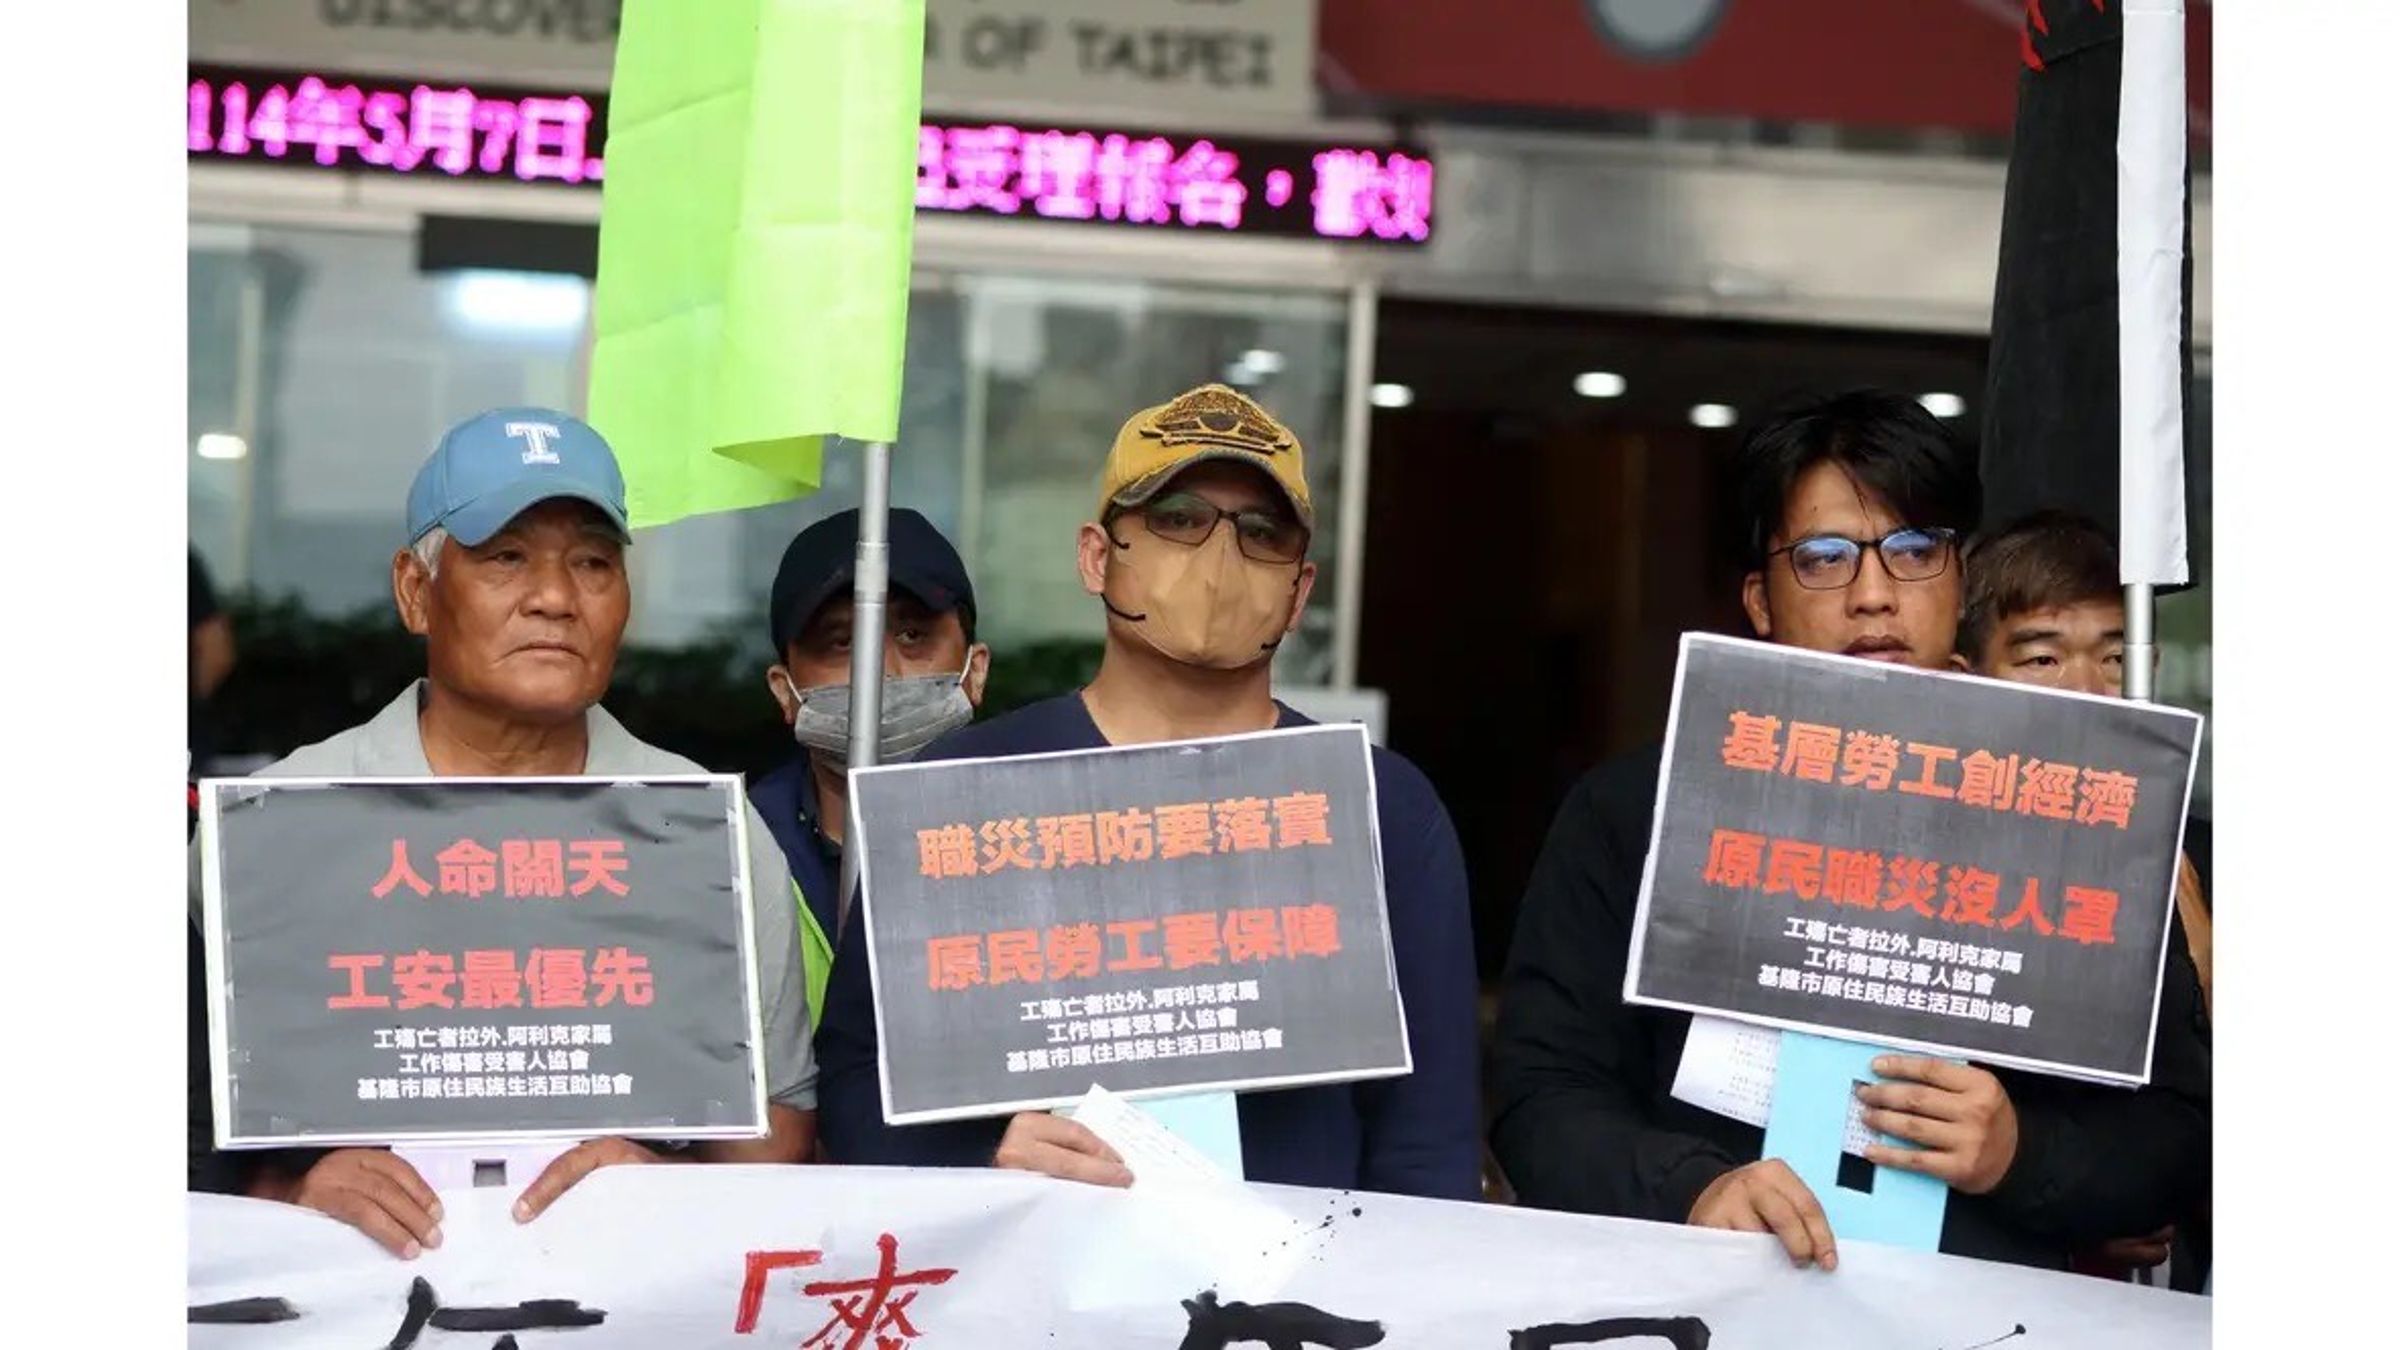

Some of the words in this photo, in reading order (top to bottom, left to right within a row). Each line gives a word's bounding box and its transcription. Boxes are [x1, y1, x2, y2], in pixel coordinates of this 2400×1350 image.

[962, 15, 1046, 73] OF
[1069, 19, 1274, 89] TAIPEI
[505, 421, 561, 465] T
[1721, 710, 2138, 830] 基層勞工創經濟
[917, 791, 1333, 879] 職災預防要落實
[372, 839, 631, 899] 人命關天
[1703, 827, 2122, 946] 原民職災沒人罩
[926, 902, 1341, 991] 原民勞工要保障
[327, 947, 654, 1011] 工安最優先
[1758, 964, 2034, 1028] 基隆市原住民族生活互助協會
[1006, 1028, 1283, 1073] 基隆市原住民族生活互助協會
[357, 1073, 633, 1100] 基隆市原住民族生活互助協會
